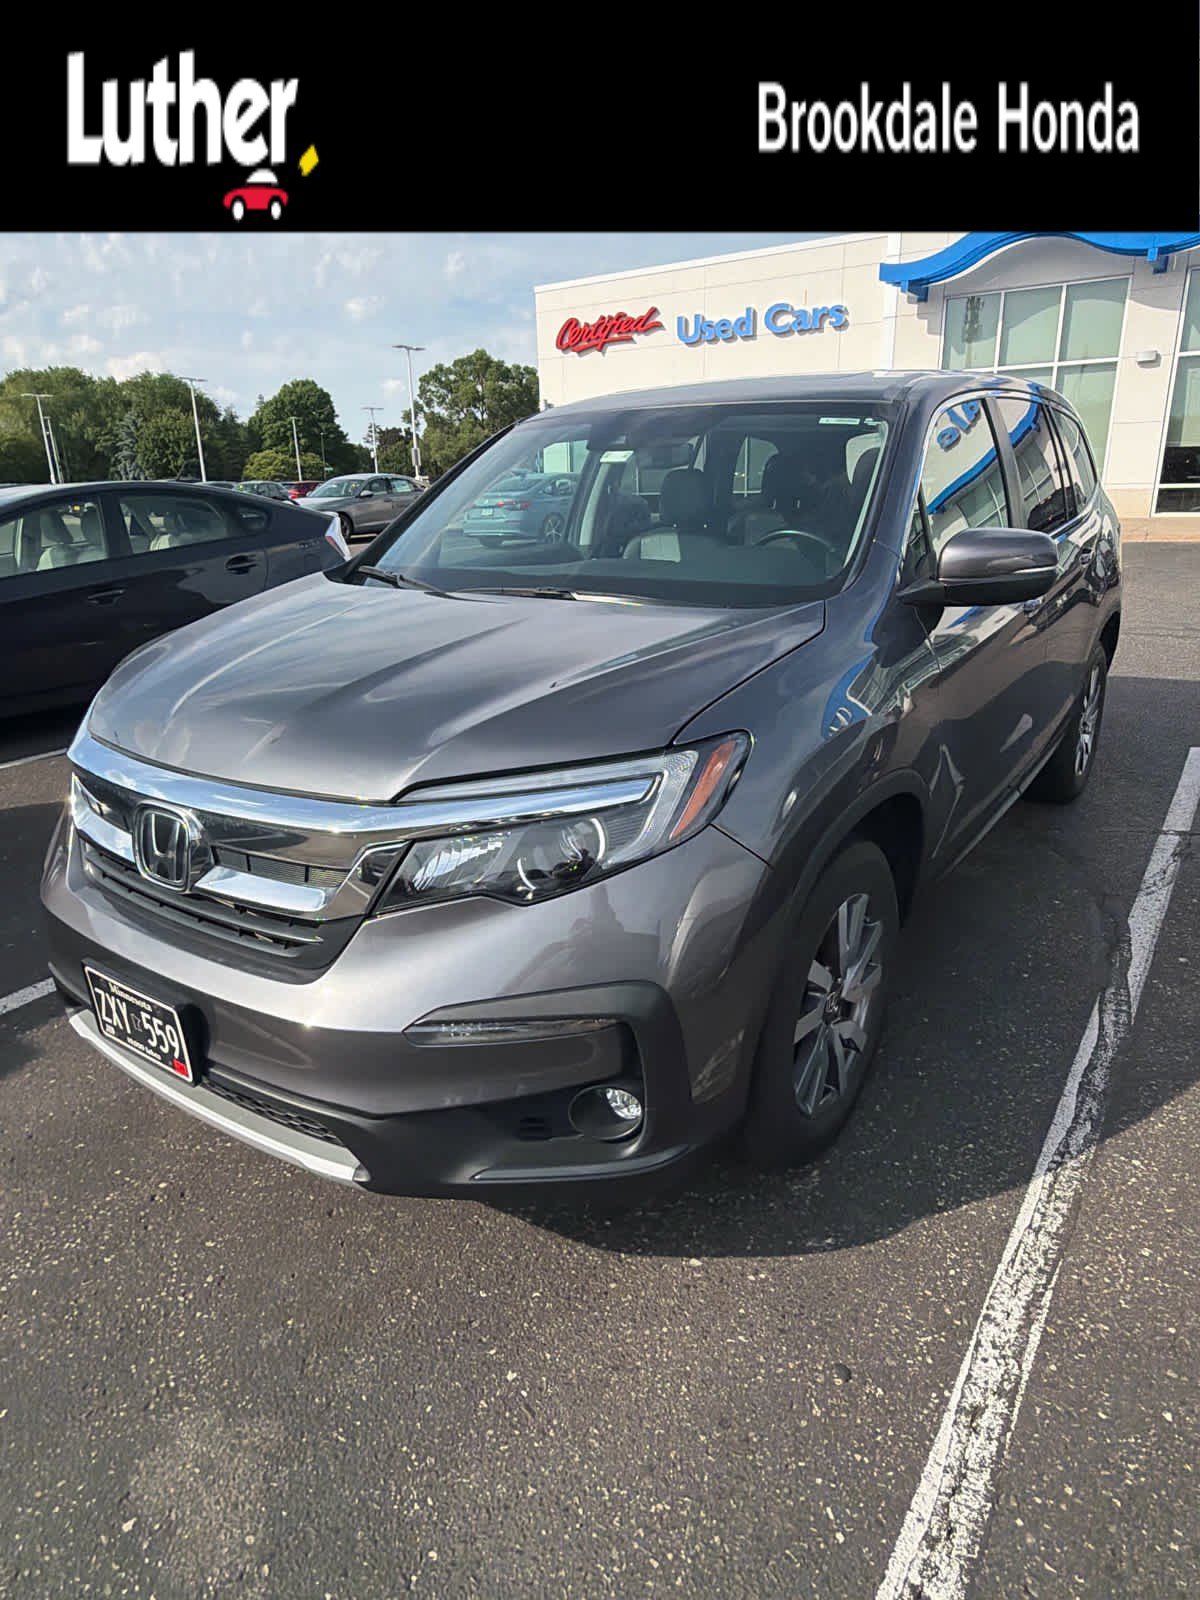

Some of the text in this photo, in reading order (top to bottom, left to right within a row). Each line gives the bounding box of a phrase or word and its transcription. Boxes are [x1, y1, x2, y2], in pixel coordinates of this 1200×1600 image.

[556, 303, 846, 353] Certified Used Cars
[95, 987, 131, 1034] ZXY
[140, 1012, 180, 1058] 559
